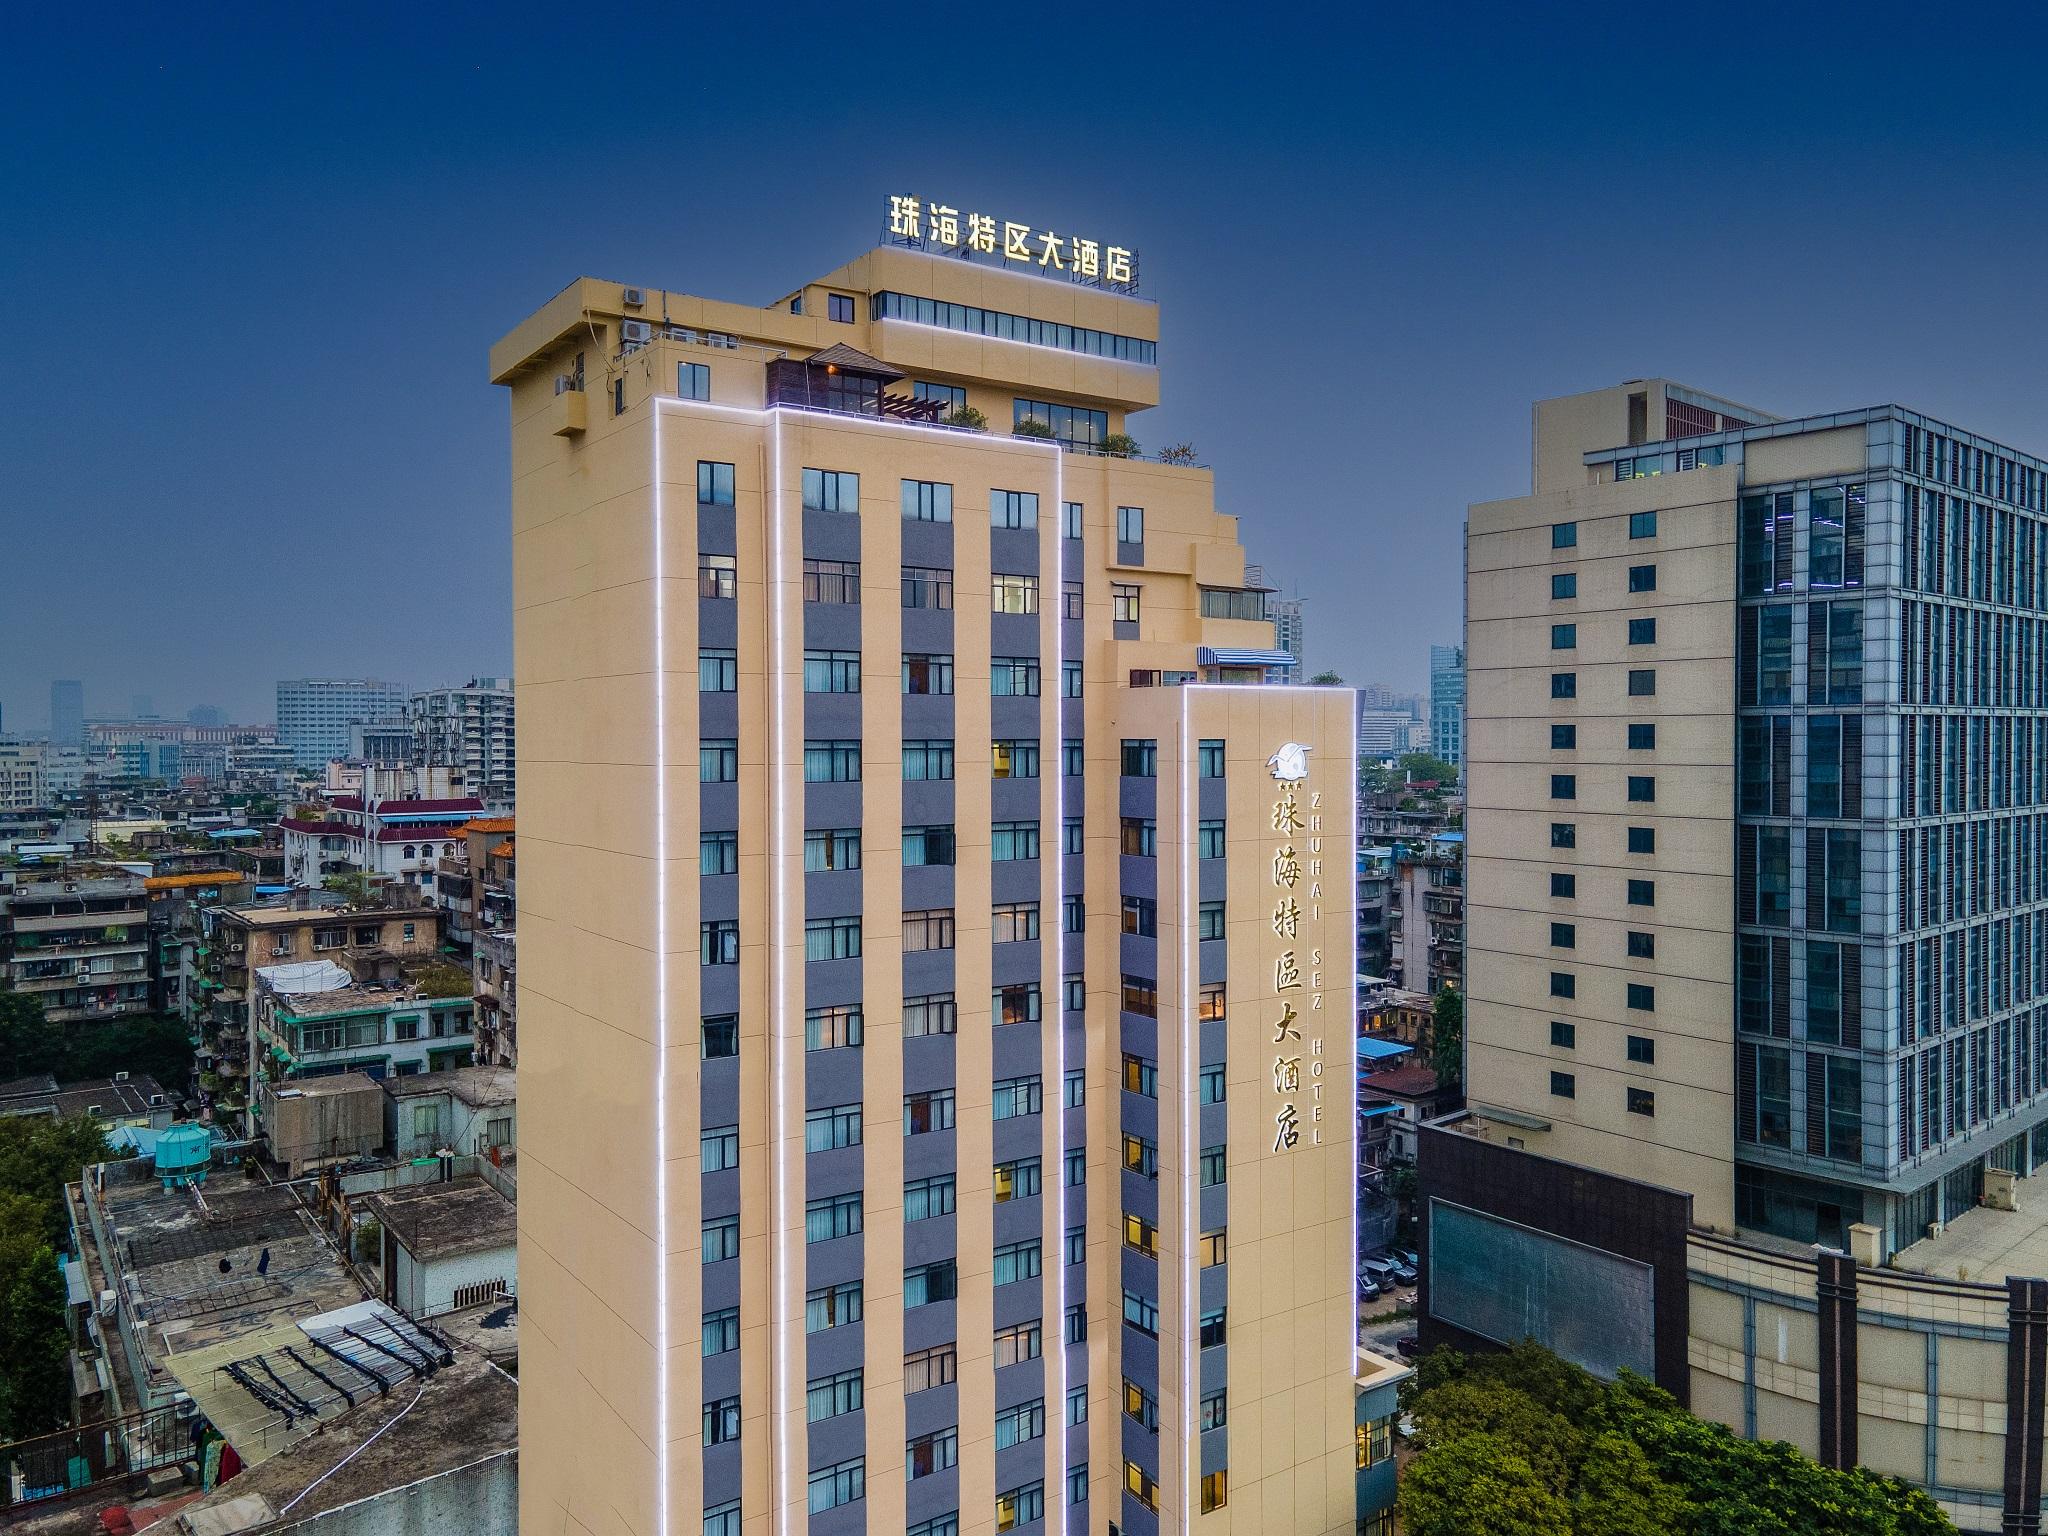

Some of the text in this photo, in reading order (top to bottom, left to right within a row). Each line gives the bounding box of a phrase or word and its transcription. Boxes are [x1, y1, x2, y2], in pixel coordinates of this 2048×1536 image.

[890, 195, 1132, 282] 珠海特区大酒店
[1272, 794, 1305, 1153] 珠海特區大酒店
[1311, 793, 1323, 1144] ZHUHAI SEZ HOTEL
